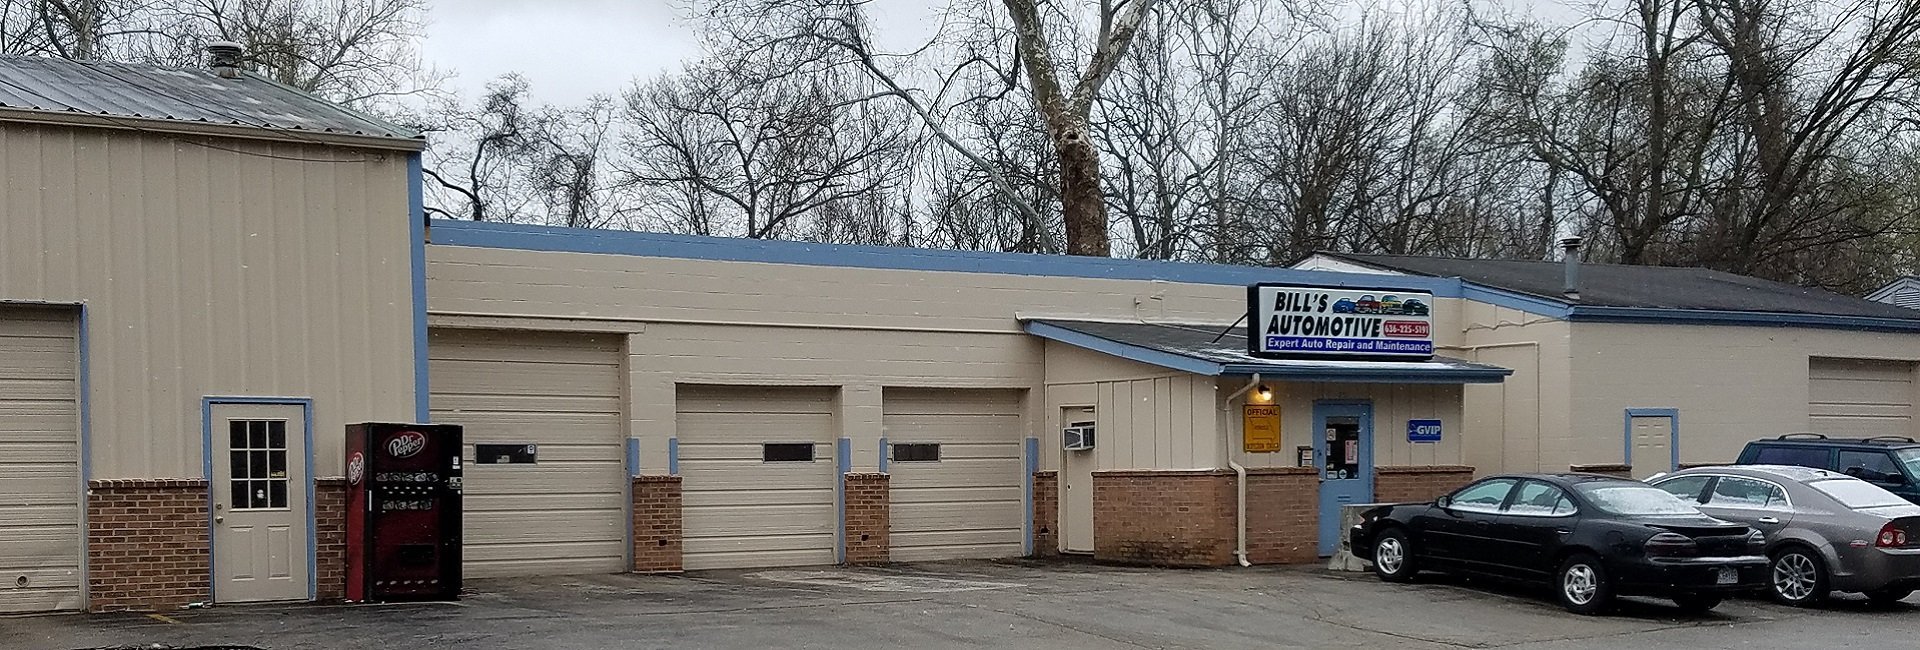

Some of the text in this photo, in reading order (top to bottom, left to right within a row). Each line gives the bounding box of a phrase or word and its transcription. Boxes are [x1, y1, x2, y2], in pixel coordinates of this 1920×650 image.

[1274, 291, 1329, 313] BILL'S
[1266, 314, 1382, 338] AUTOMOTIVE
[1384, 323, 1430, 335] 636-225-5191
[1268, 337, 1431, 352] Expert Auto Repair and Maintenance
[1246, 408, 1278, 416] OFFICIAL
[1416, 425, 1441, 435] GVIP
[400, 434, 414, 446] Dr
[388, 437, 422, 457] Pepper
